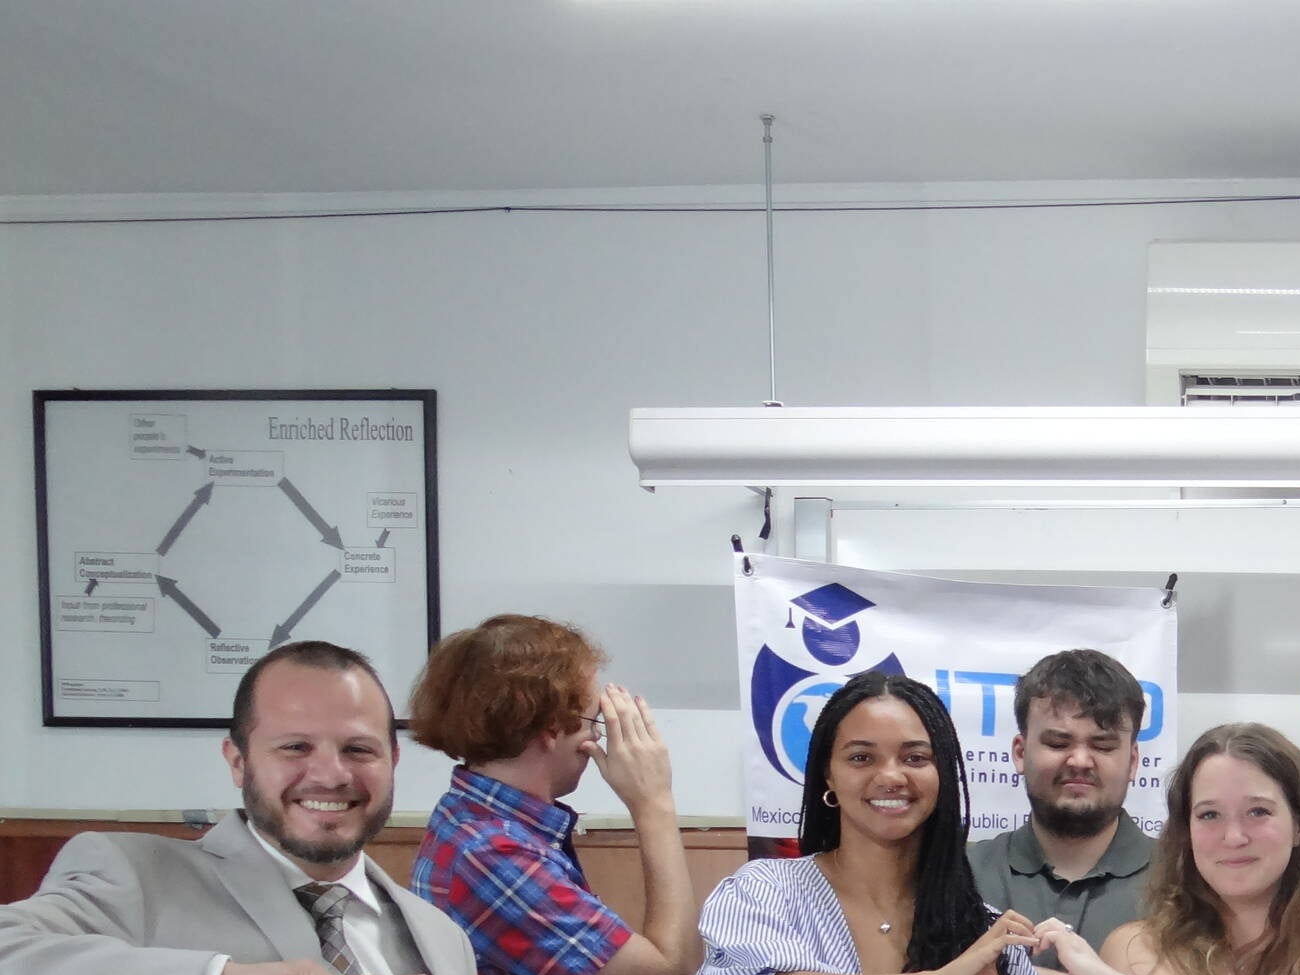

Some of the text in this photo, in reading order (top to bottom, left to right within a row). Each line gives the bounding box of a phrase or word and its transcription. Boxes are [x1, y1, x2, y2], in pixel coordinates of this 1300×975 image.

[268, 416, 414, 442] Enriched Reflection
[371, 509, 413, 521] Experience
[79, 556, 114, 567] Abstract
[343, 551, 381, 562] Concrete
[344, 564, 390, 576] Experience
[210, 642, 250, 653] Reflective
